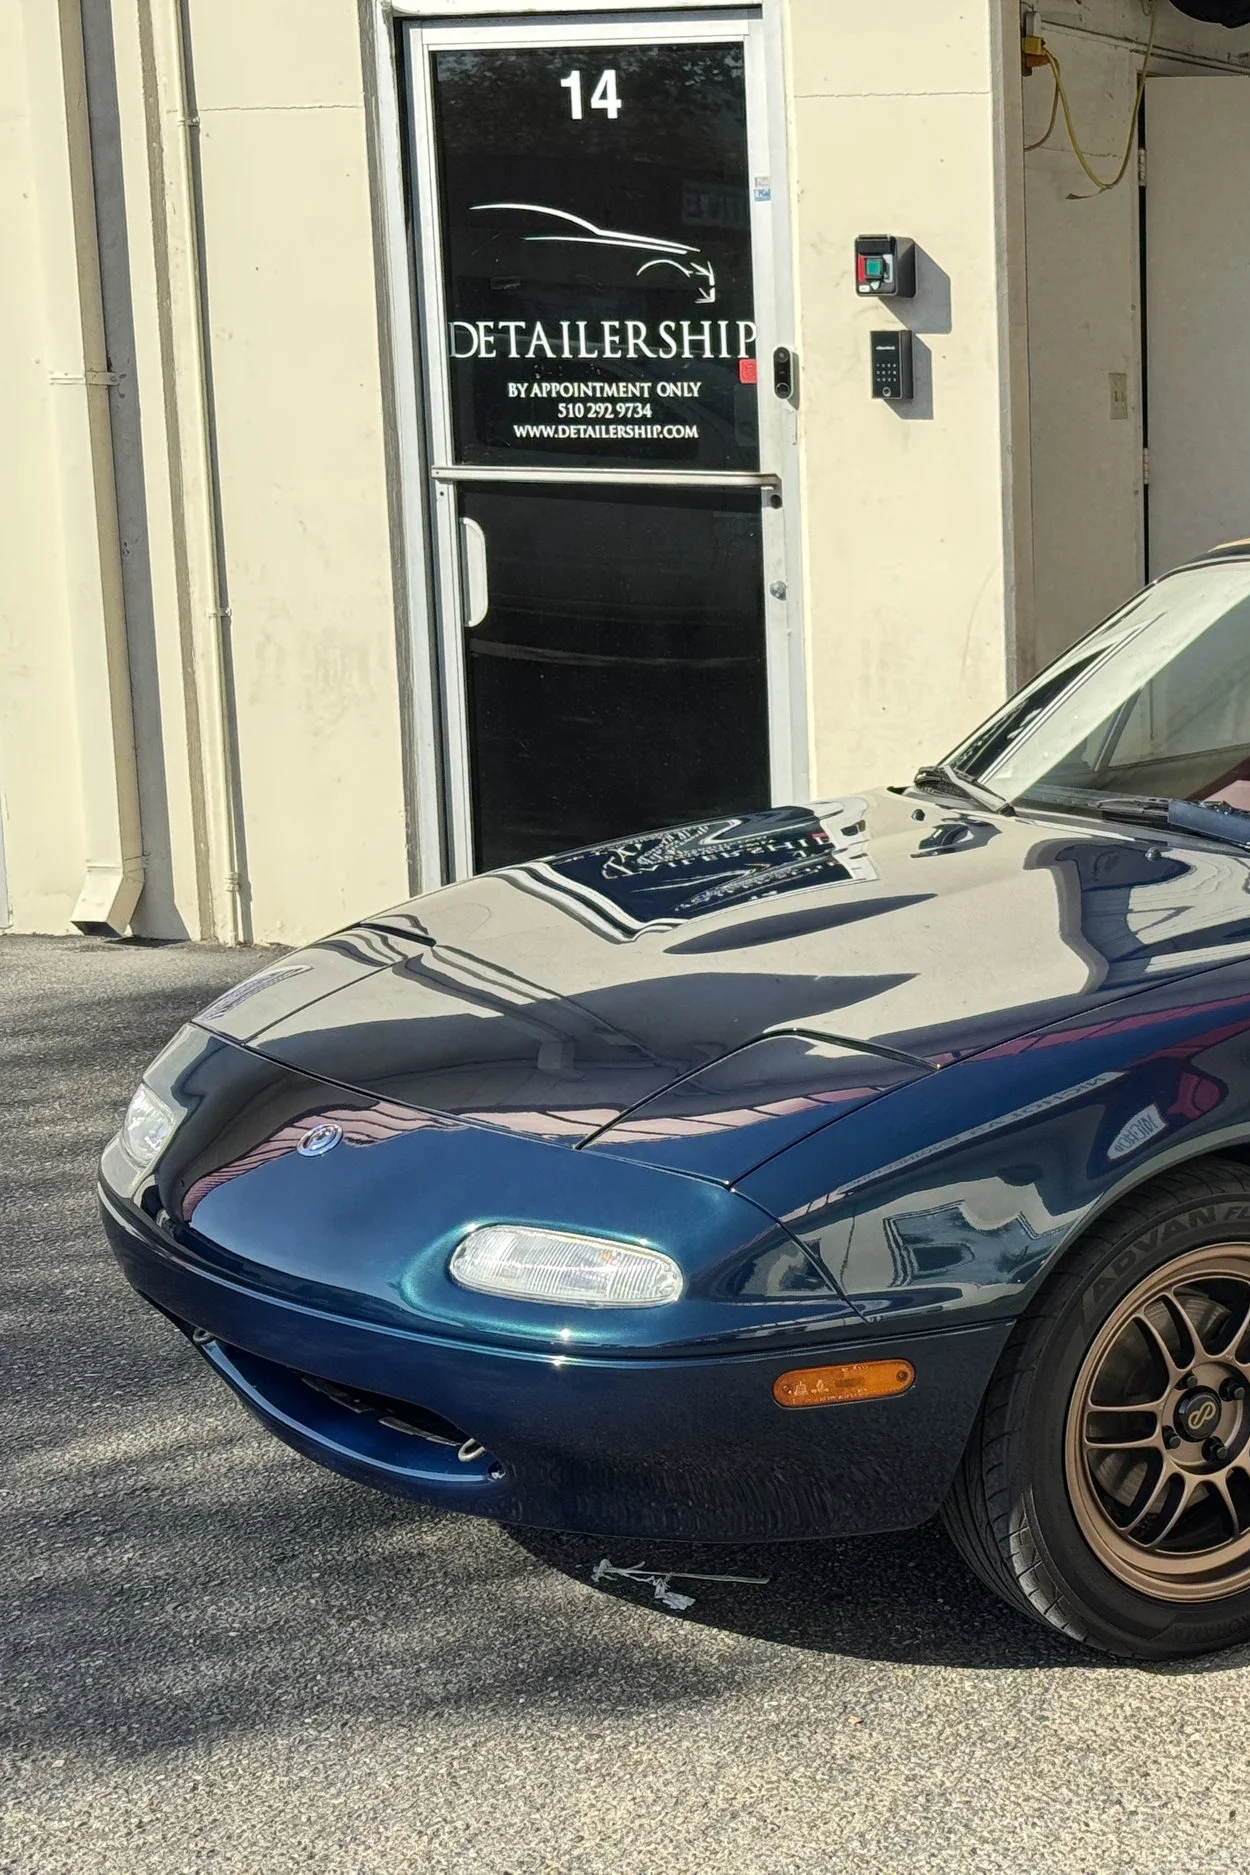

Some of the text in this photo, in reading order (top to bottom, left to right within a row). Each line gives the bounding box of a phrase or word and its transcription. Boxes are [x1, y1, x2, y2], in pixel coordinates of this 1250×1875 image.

[560, 69, 622, 120] 14
[448, 320, 757, 359] DETAILERSHIP
[507, 381, 702, 398] BY APPOINTMENT ONLY
[557, 402, 653, 418] 510 292 9734
[513, 424, 700, 439] WWW.DETAILERSHIP.COM
[1091, 1206, 1217, 1296] ADVAN
